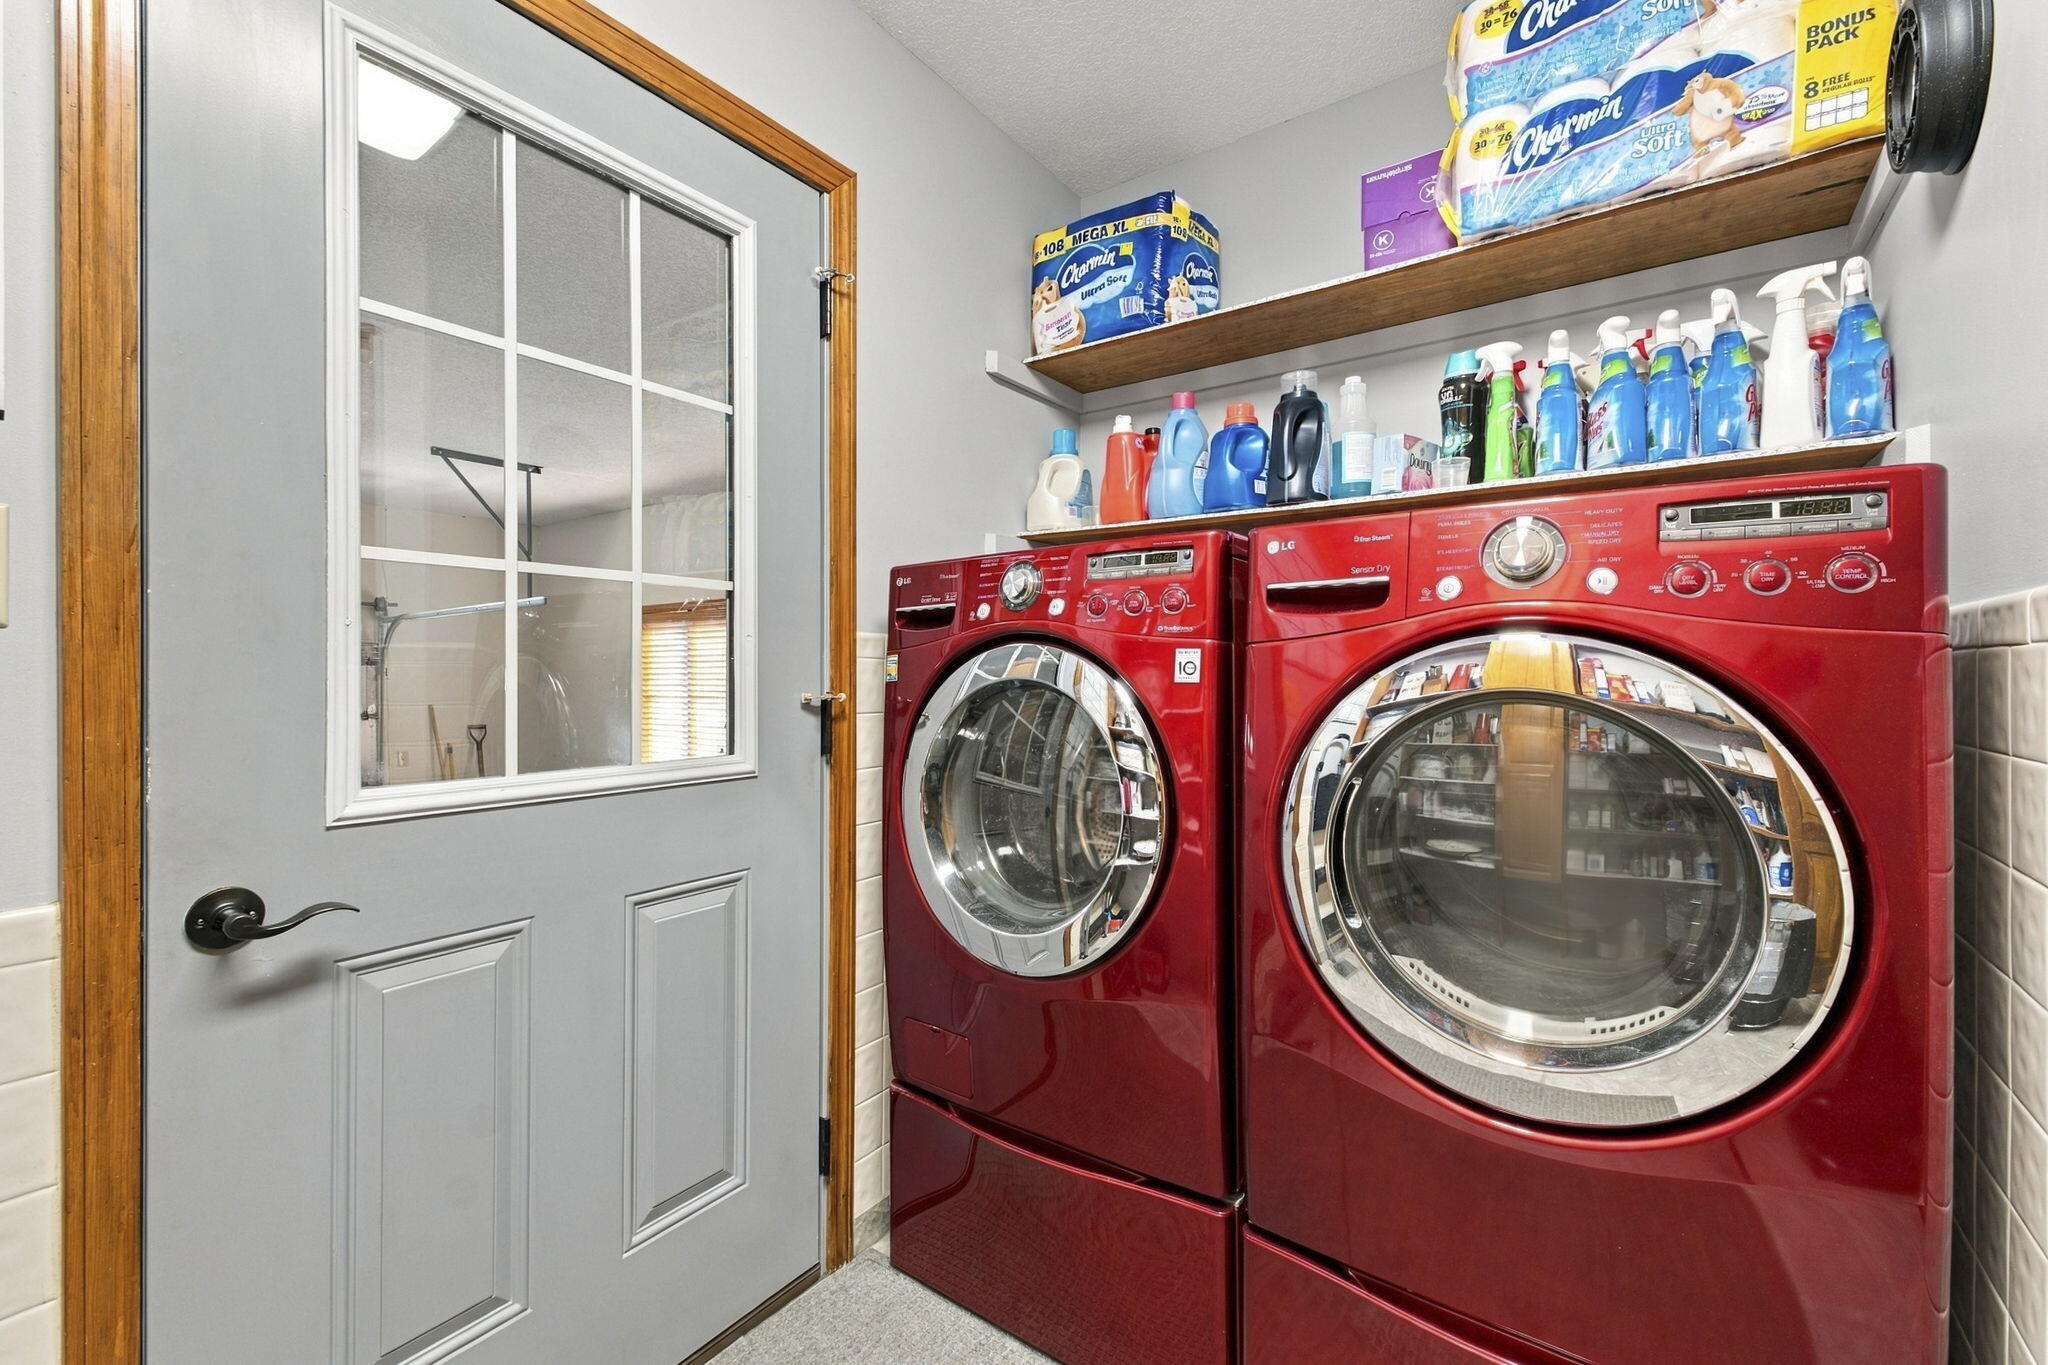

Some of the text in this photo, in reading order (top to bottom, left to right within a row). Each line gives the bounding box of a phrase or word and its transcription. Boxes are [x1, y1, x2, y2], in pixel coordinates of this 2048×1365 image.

[1480, 19, 1492, 31] 30
[1503, 8, 1517, 22] 76
[1807, 8, 1876, 39] BONUS
[1805, 26, 1860, 53] PACK
[1804, 81, 1819, 99] 8
[1822, 72, 1850, 87] FREE
[1512, 95, 1623, 167] Charmin
[1640, 120, 1676, 139] Ultra
[1474, 139, 1487, 152] 30
[1497, 131, 1512, 144] 76
[1631, 127, 1686, 158] Soft
[1366, 163, 1413, 183] simplehuman
[1043, 239, 1064, 256] 108
[1071, 225, 1108, 246] MEGA
[1113, 221, 1128, 235] XL
[1173, 224, 1188, 239] 108
[1378, 234, 1389, 247] K
[1061, 249, 1115, 289] Charmin
[1186, 261, 1214, 283] Charmin
[1081, 274, 1127, 301] Ultra Soft
[1281, 540, 1296, 551] LG
[1350, 564, 1391, 575] Sensor Dry
[1178, 661, 1197, 676] 10
